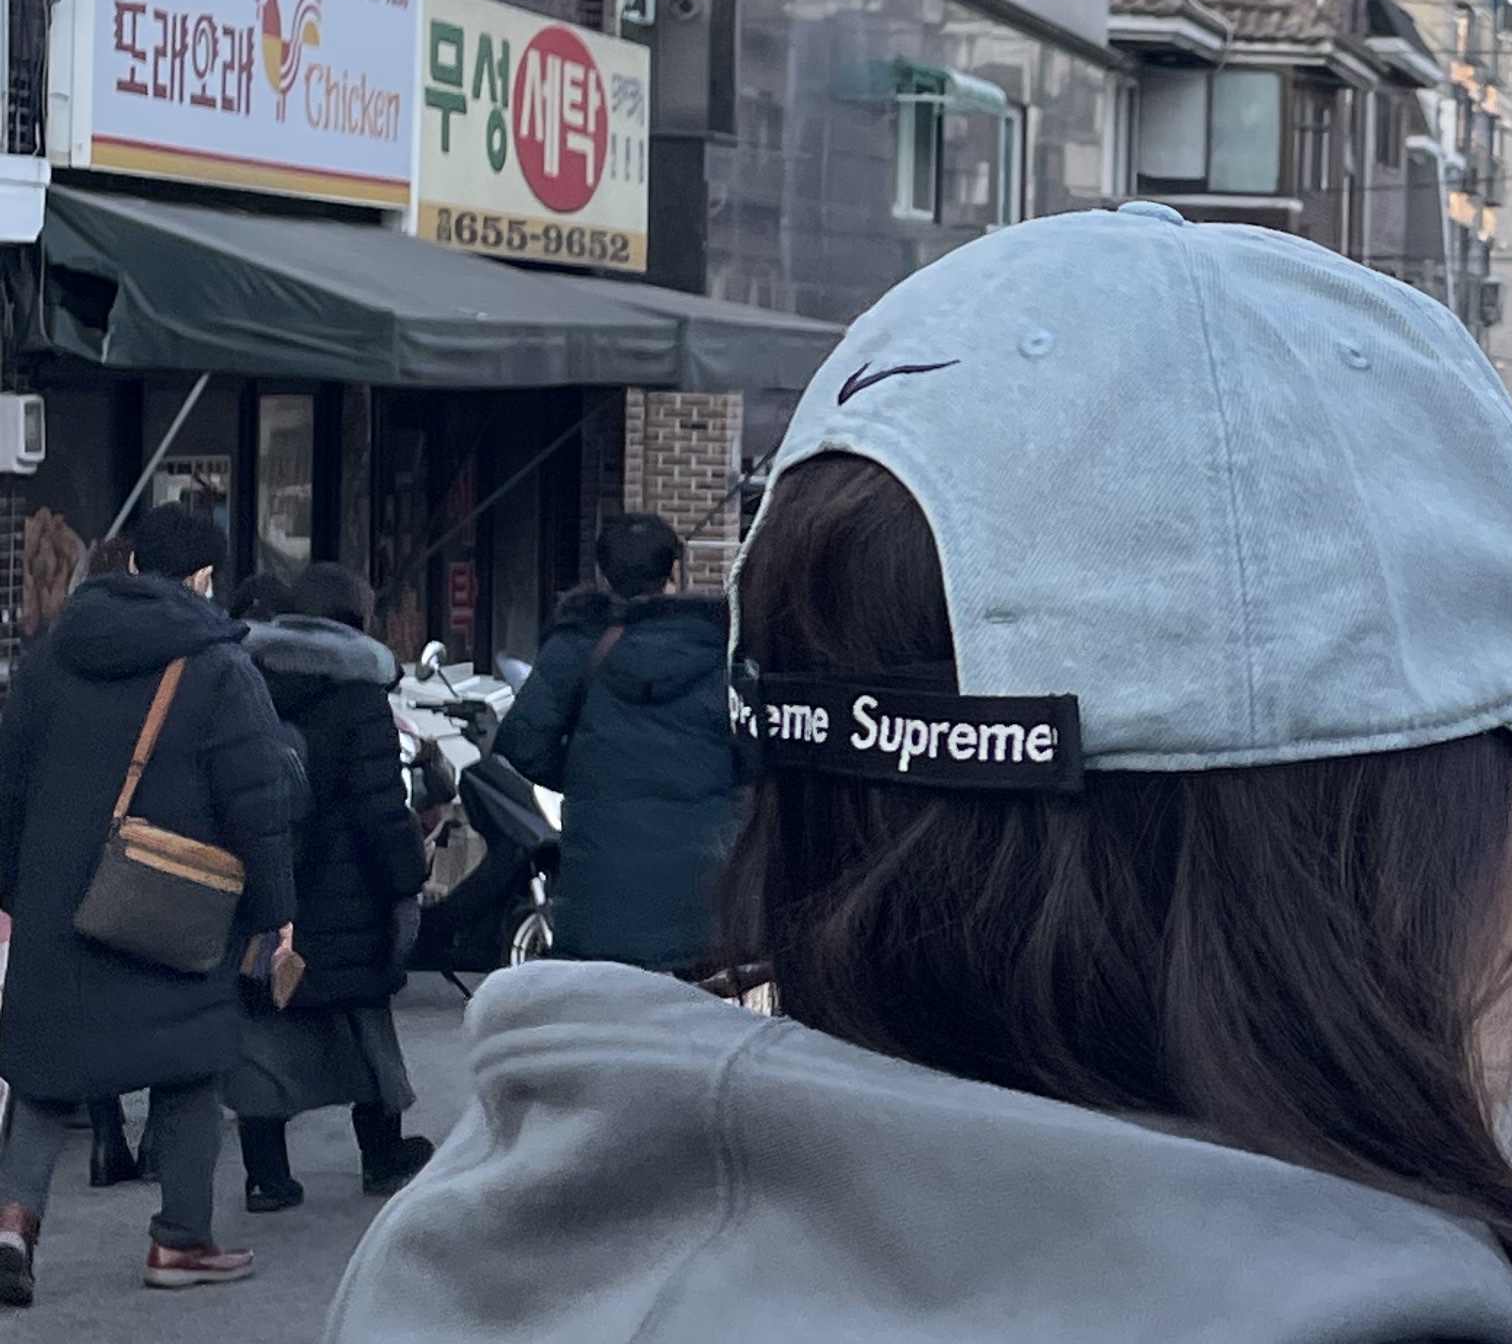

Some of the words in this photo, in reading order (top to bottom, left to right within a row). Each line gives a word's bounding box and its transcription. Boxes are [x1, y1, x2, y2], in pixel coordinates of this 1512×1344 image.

[304, 63, 401, 142] Chicken
[424, 17, 510, 175] 무성
[518, 48, 601, 188] 세탁
[850, 694, 1058, 772] Supreme
